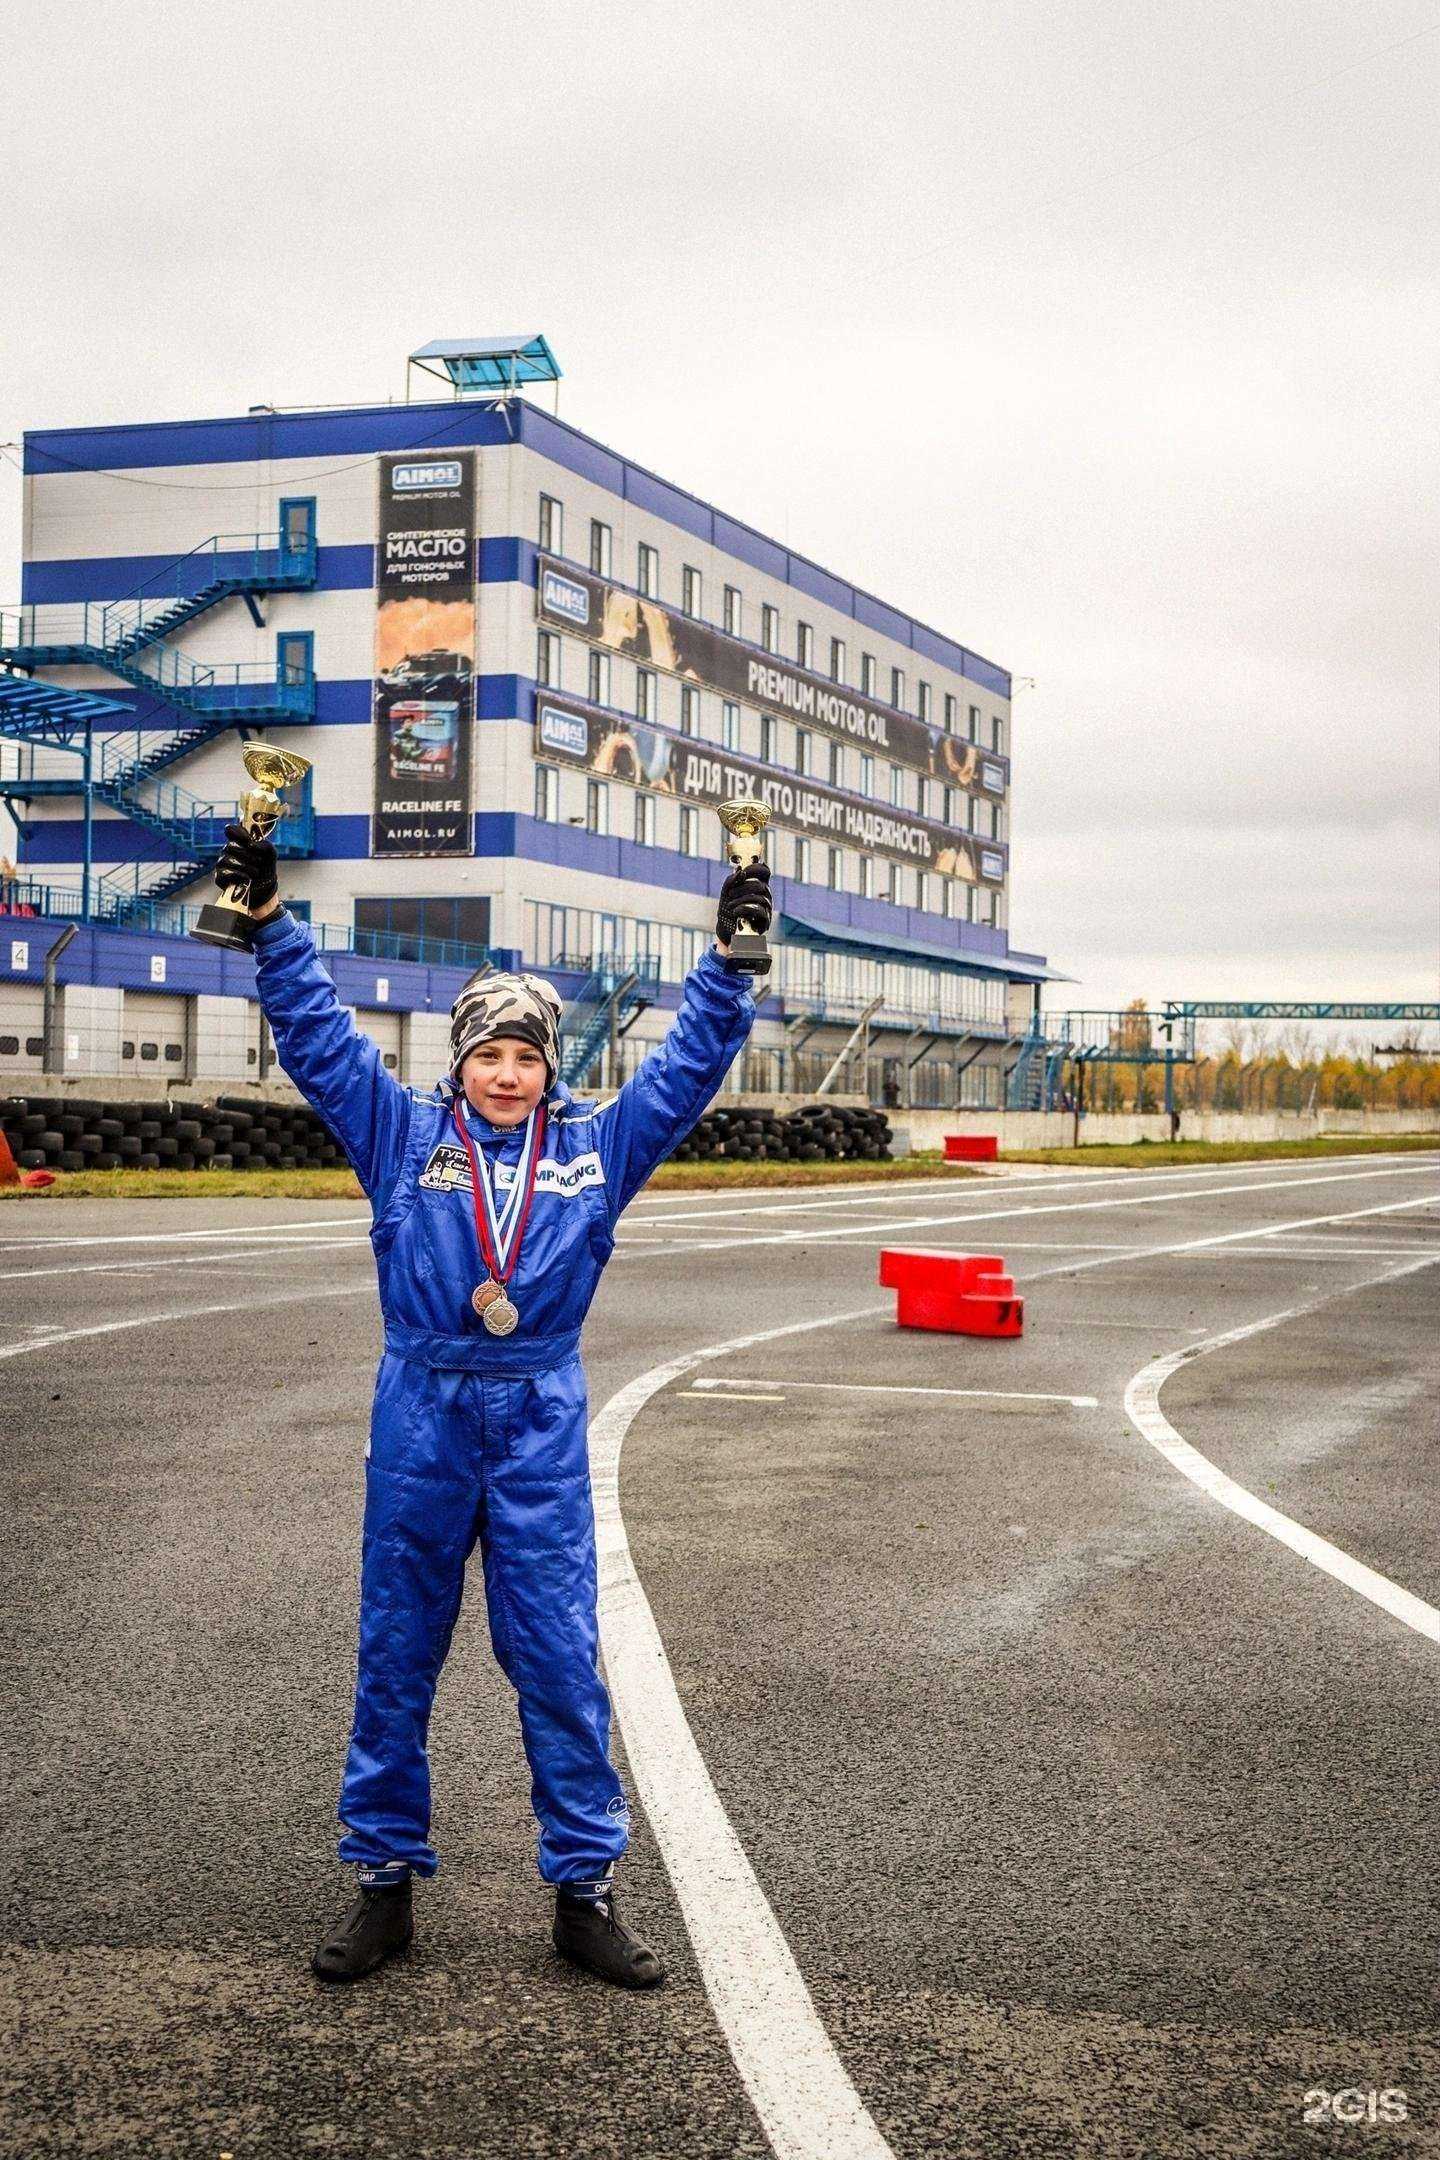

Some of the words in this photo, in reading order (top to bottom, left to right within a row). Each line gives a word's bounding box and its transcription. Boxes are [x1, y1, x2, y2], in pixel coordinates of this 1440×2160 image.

[386, 528, 467, 541] СИНТЕТИЧЕСКОЕ
[386, 538, 466, 559] МАСЛО
[386, 564, 407, 574] ДЛЯ
[408, 560, 466, 572] ГОНОЧНЫХ
[401, 572, 450, 583] МОТОРОВ
[748, 660, 815, 717] PREMIUM
[816, 691, 867, 737] MOTOR
[866, 713, 889, 747] OIL
[382, 800, 444, 813] RACELINE
[445, 800, 462, 812] FE
[683, 753, 722, 796] ДЛЯ
[761, 778, 794, 816] КТО
[795, 790, 844, 831] ЦЕНИТ
[845, 810, 931, 857] НАДЕЖНОСТЬ
[387, 828, 456, 839] AIMOL.RU
[15, 948, 25, 963] 4
[1158, 1023, 1172, 1042] 1
[357, 1871, 376, 1882] OMP
